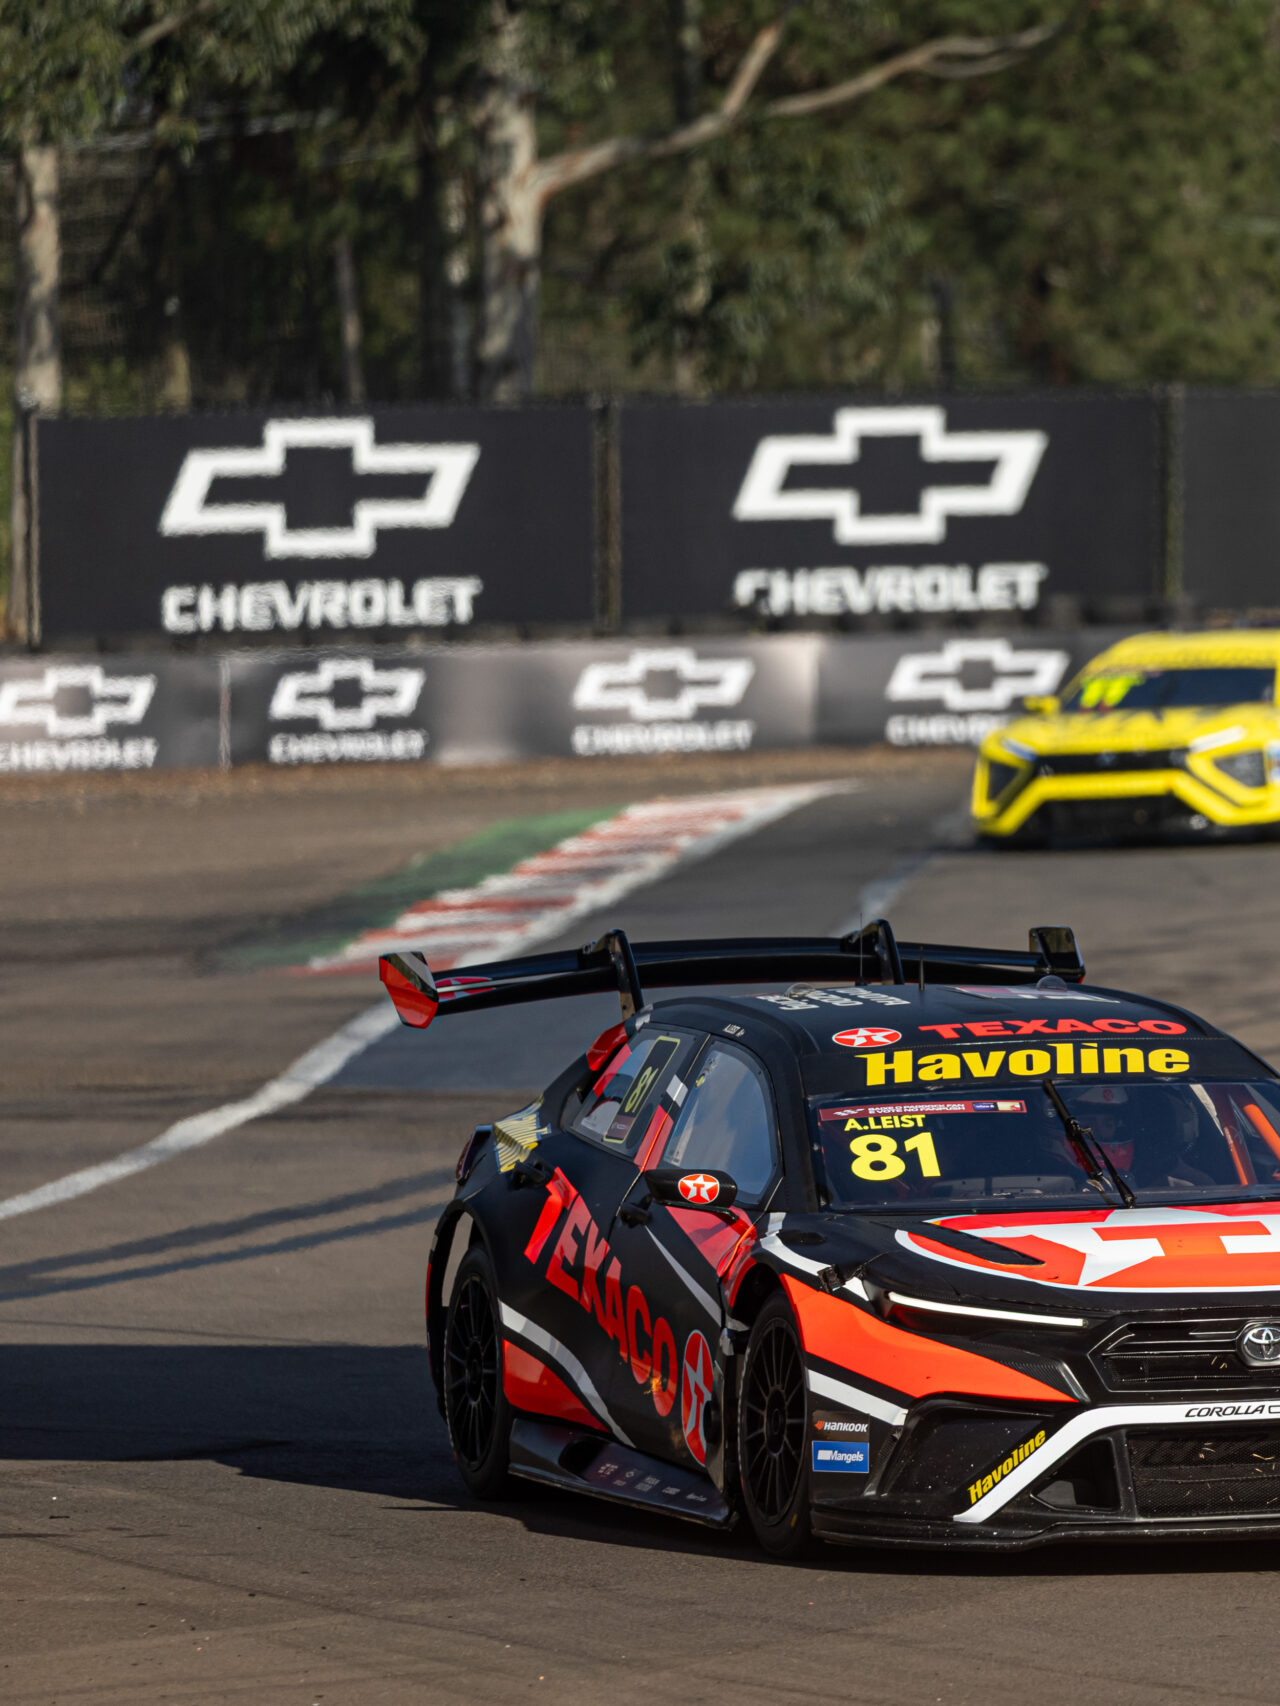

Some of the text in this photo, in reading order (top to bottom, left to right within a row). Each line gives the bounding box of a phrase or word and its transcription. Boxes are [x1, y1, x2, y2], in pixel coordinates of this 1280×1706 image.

[162, 575, 483, 634] CHEVROLET
[735, 562, 1047, 615] CHEVROLET
[269, 728, 427, 764] CHEVROLET
[572, 719, 755, 755] CHEVROLET
[918, 1018, 1187, 1039] TEXACO
[854, 1042, 1190, 1086] Havoline
[844, 1114, 926, 1131] A.LEIST
[849, 1131, 941, 1181] 81
[523, 1166, 678, 1417] TEXACO
[1185, 1404, 1265, 1418] COROLLA
[829, 1450, 864, 1464] Mangels
[967, 1429, 1046, 1505] Havoline
